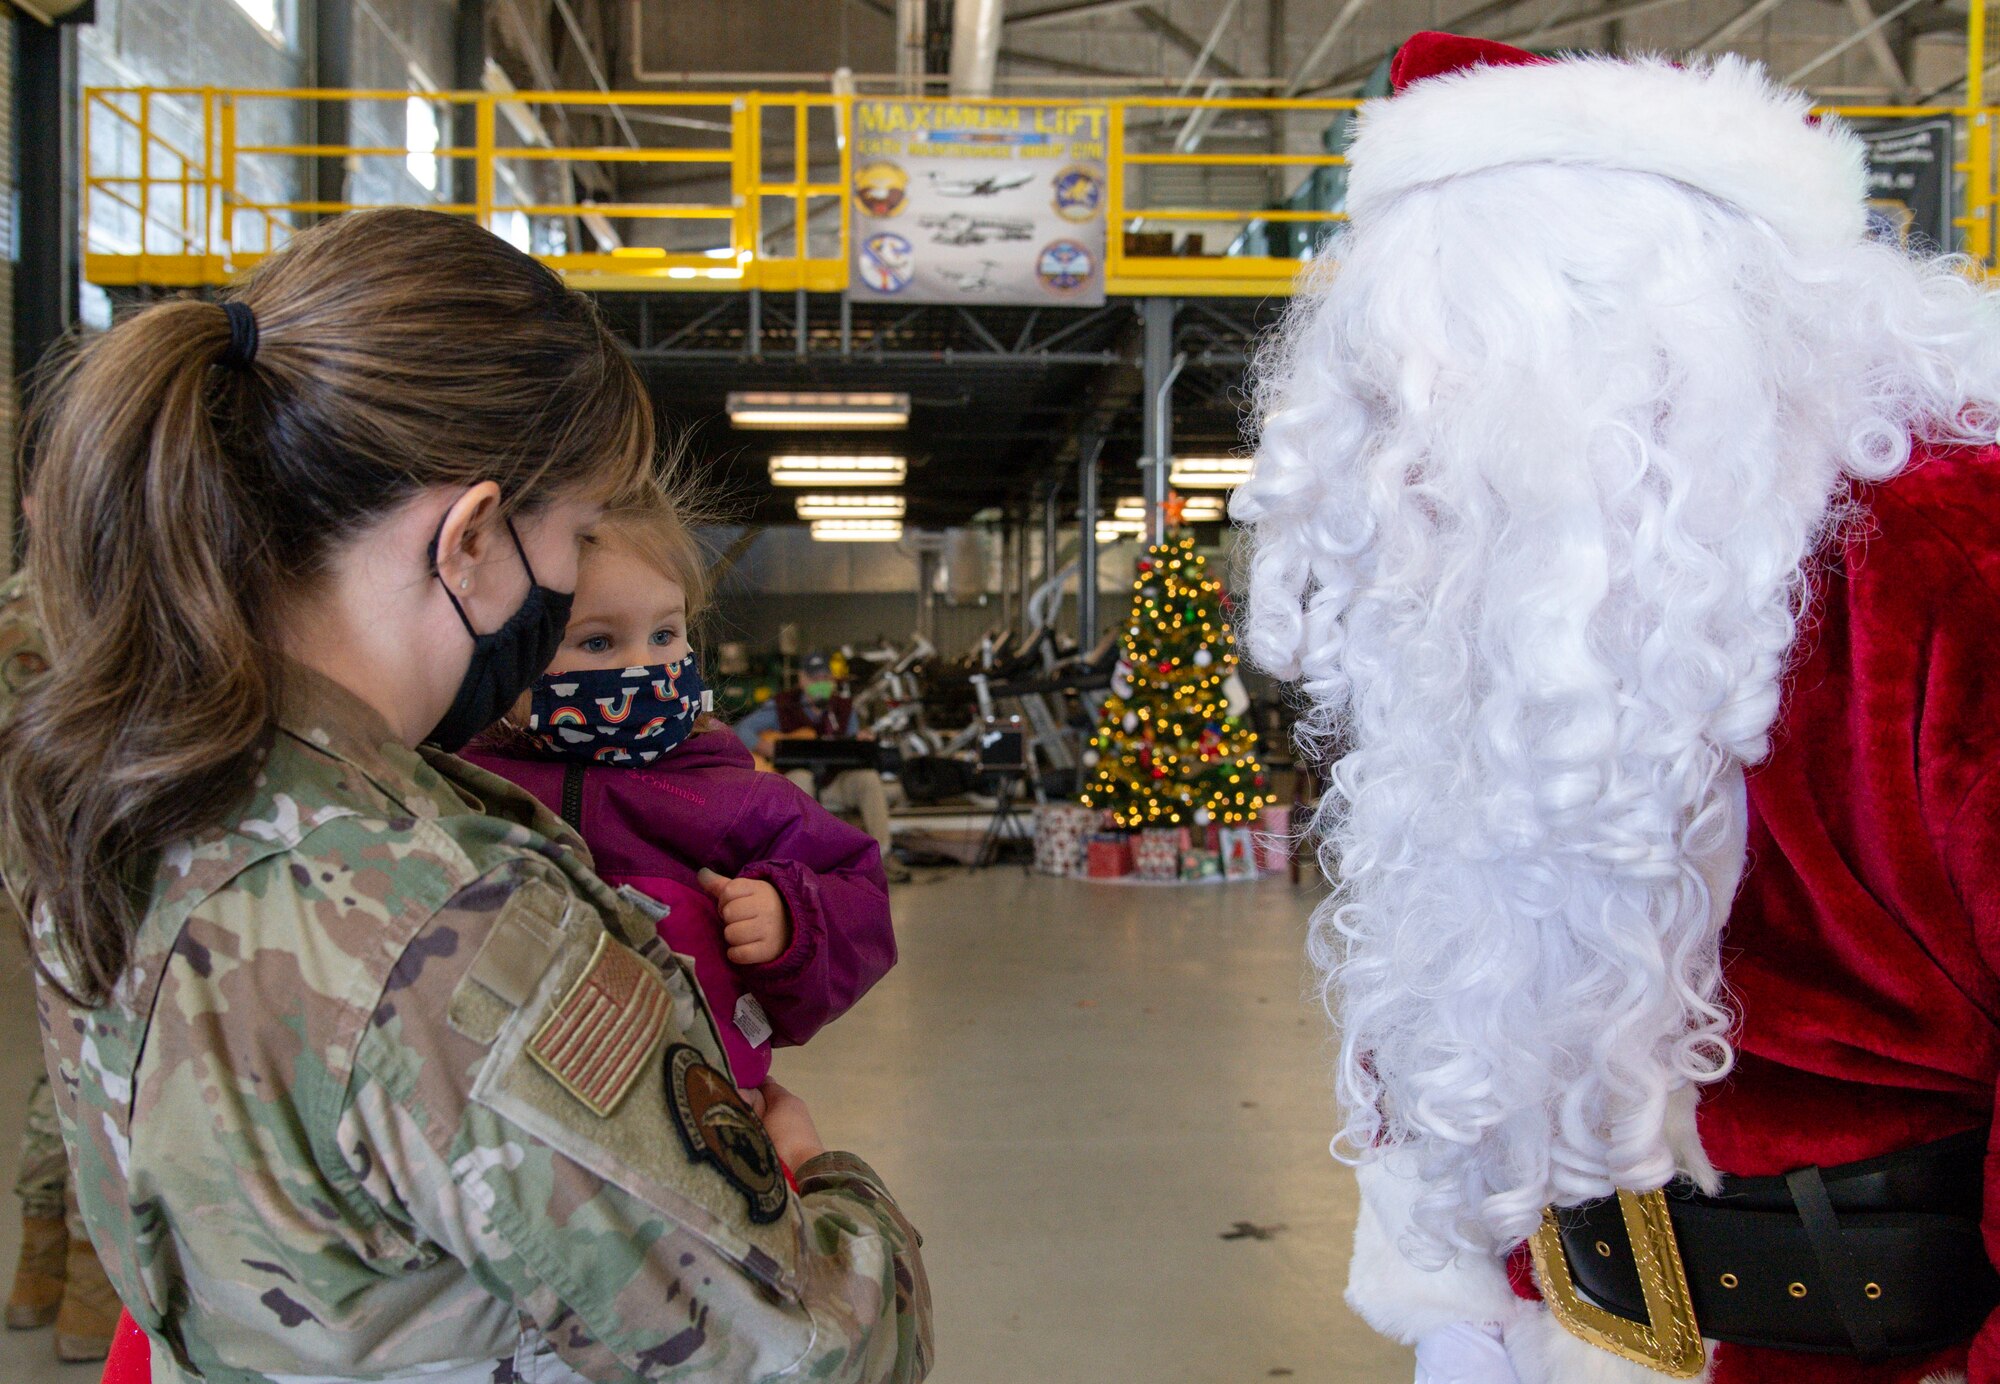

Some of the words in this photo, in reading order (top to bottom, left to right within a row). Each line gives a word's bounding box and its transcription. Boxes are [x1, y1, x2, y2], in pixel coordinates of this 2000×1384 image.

[858, 104, 1019, 132] MAXIMUM
[1034, 106, 1105, 138] LIFT
[642, 775, 706, 806] Columbia
